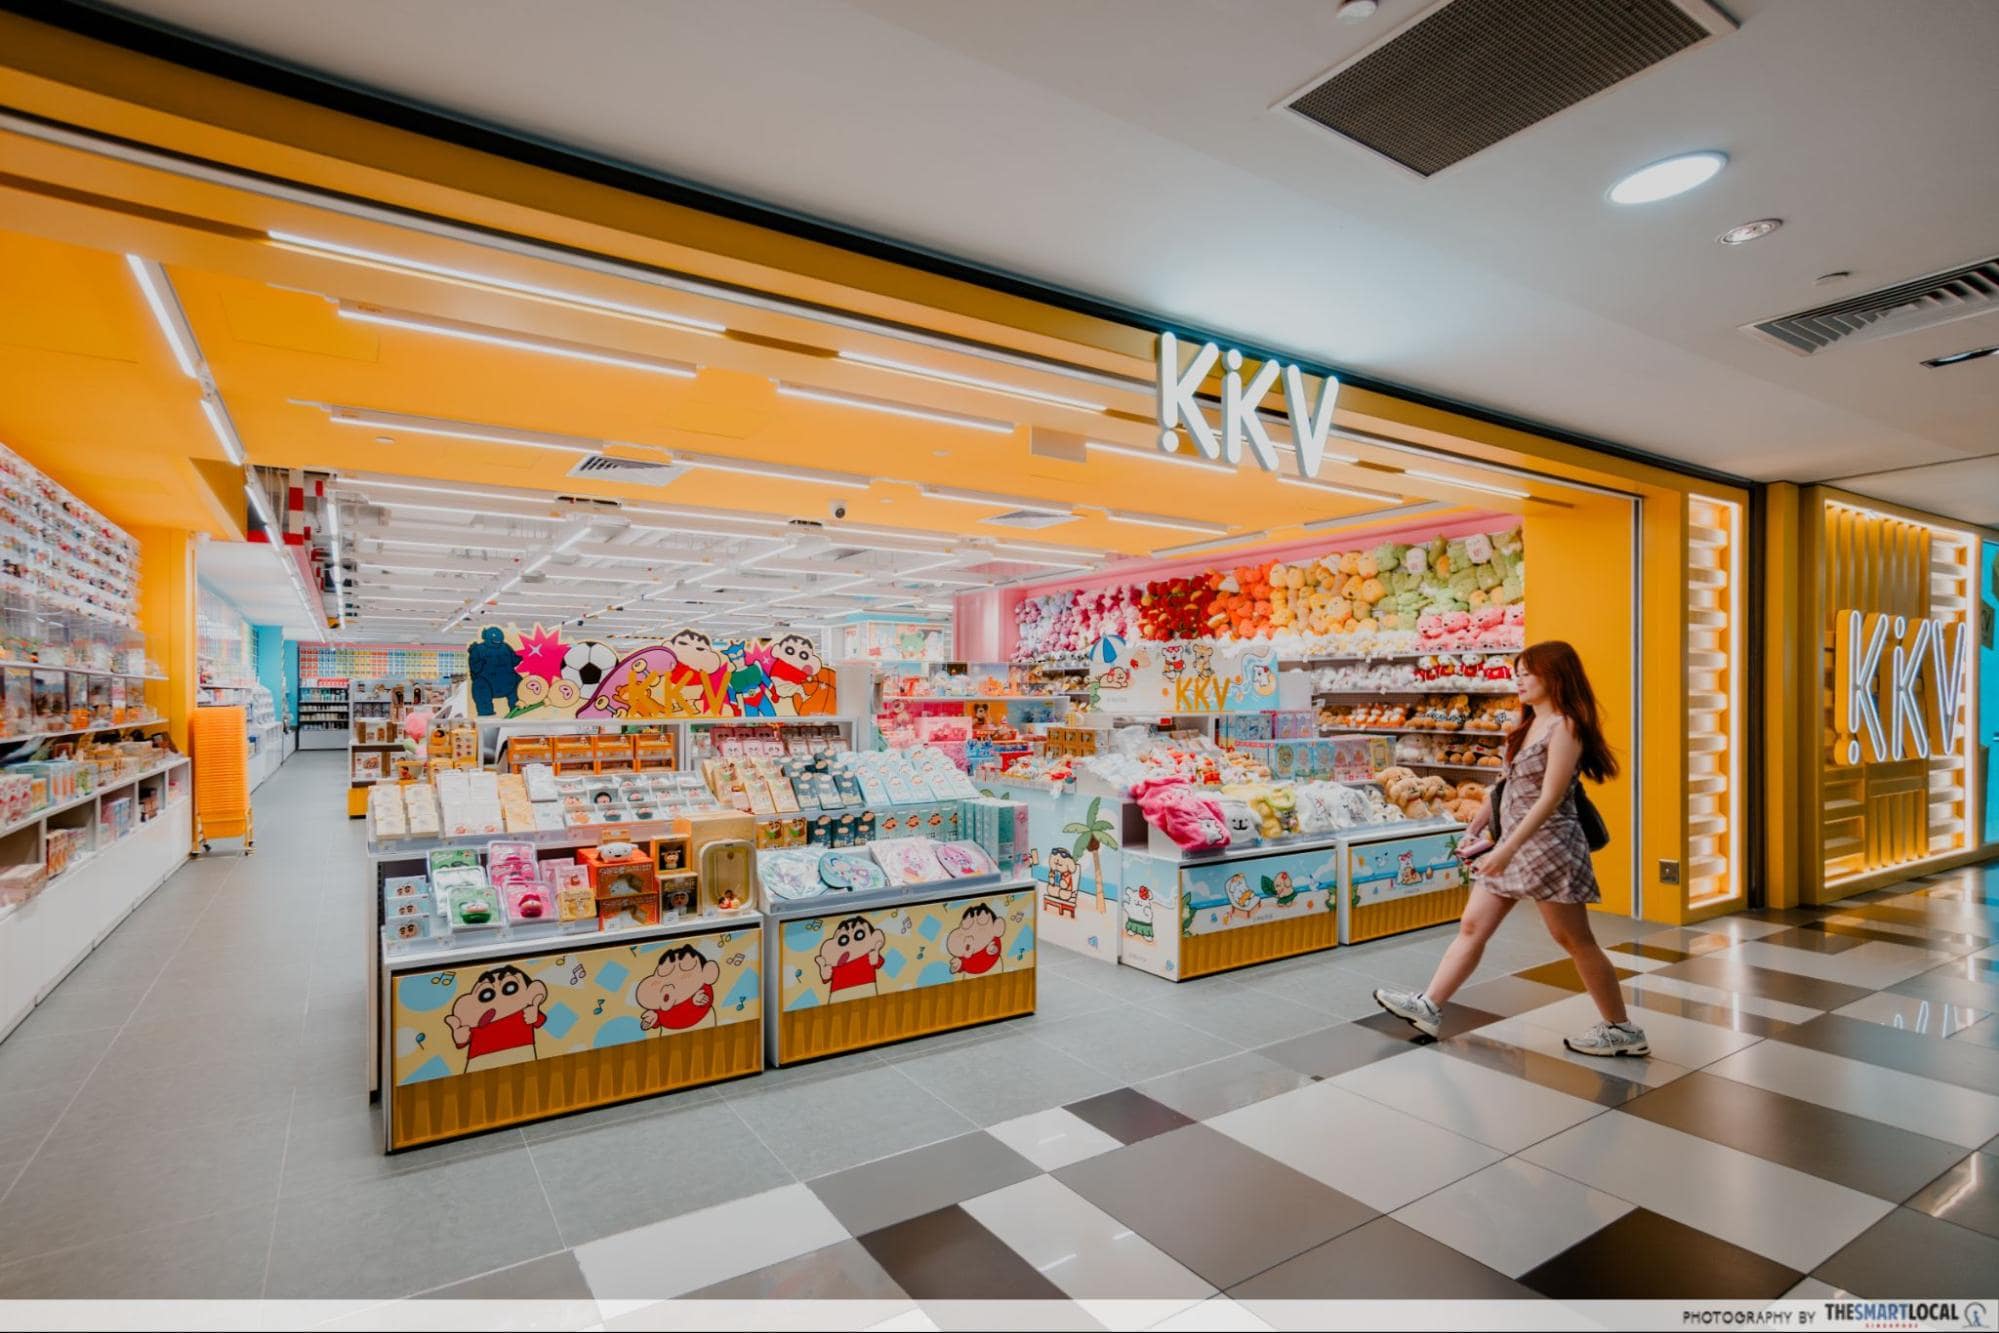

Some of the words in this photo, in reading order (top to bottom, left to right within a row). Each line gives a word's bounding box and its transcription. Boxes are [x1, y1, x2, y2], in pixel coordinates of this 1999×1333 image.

[1159, 331, 1339, 478] KKV
[628, 670, 732, 717] KKV
[1175, 675, 1231, 712] KKV
[1845, 609, 1967, 765] KKV
